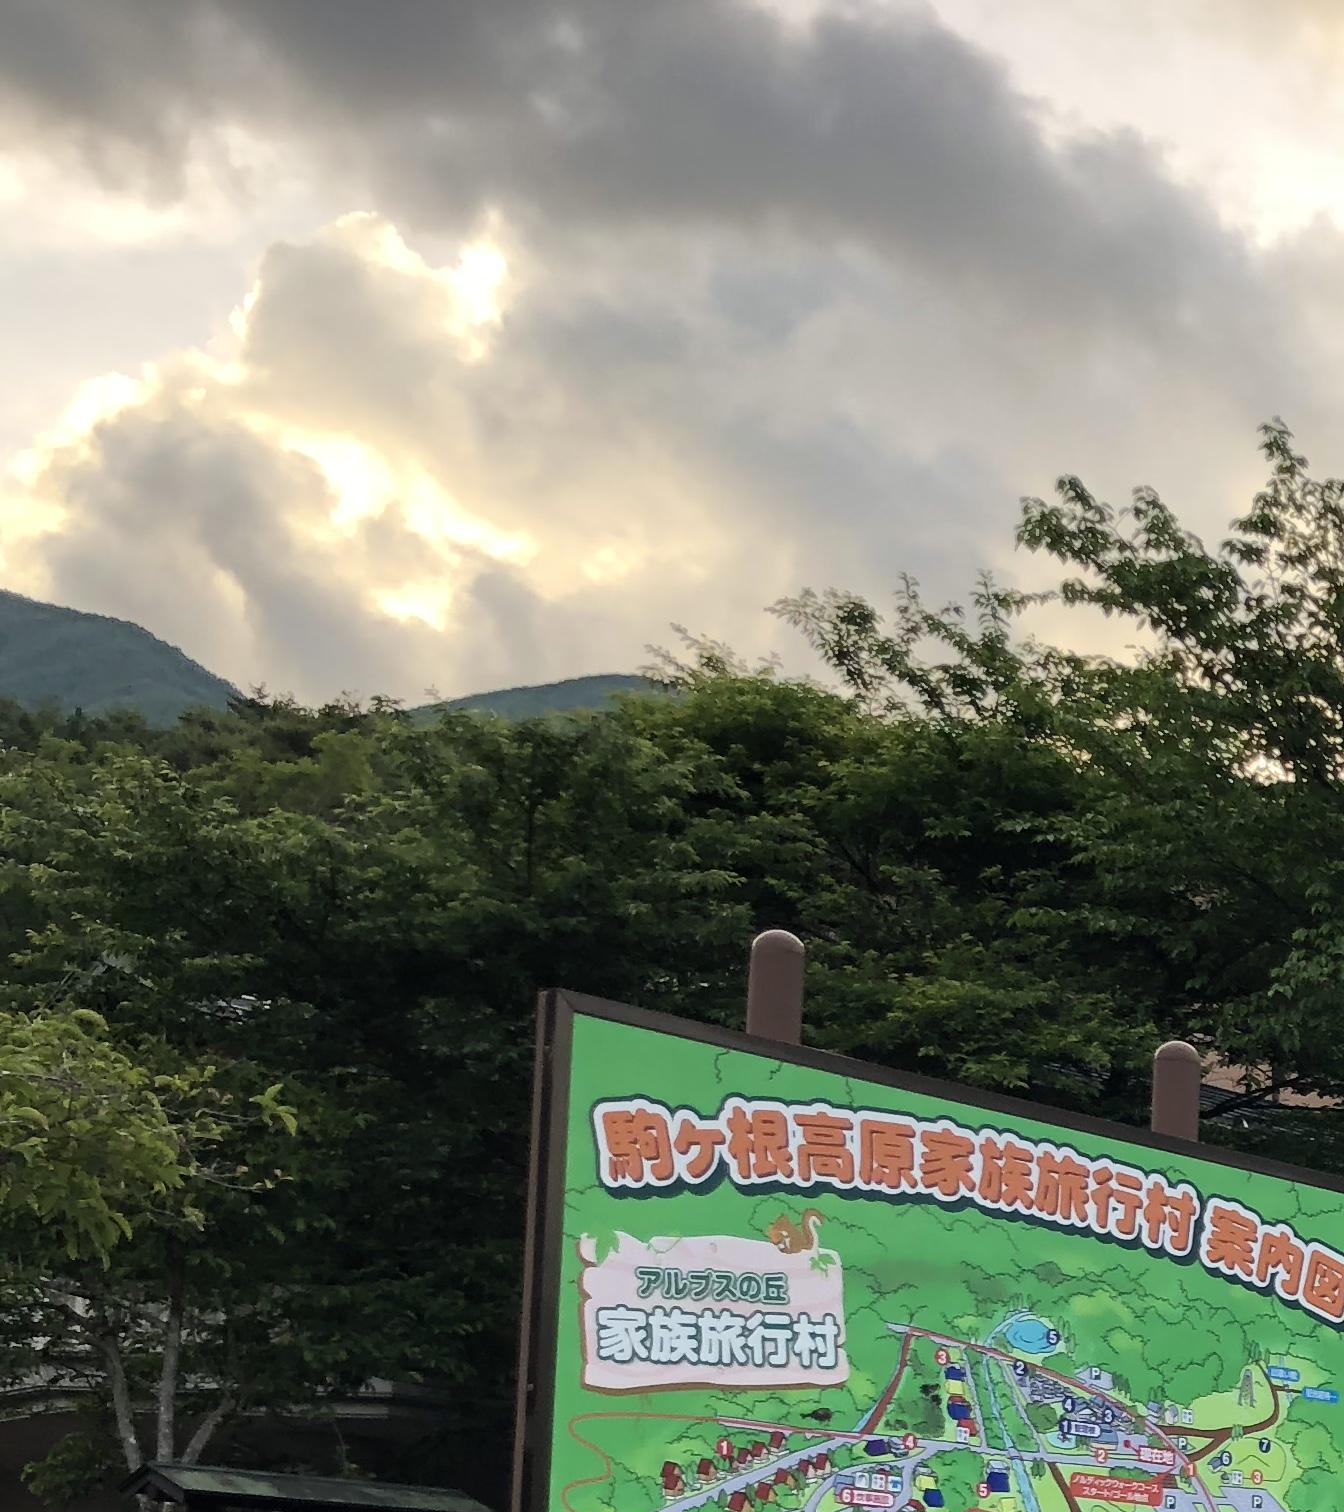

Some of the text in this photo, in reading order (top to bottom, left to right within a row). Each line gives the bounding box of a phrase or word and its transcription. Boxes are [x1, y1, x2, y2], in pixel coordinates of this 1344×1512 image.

[637, 1267, 790, 1304] アルプスの丘
[597, 1305, 839, 1369] 家族旅行村
